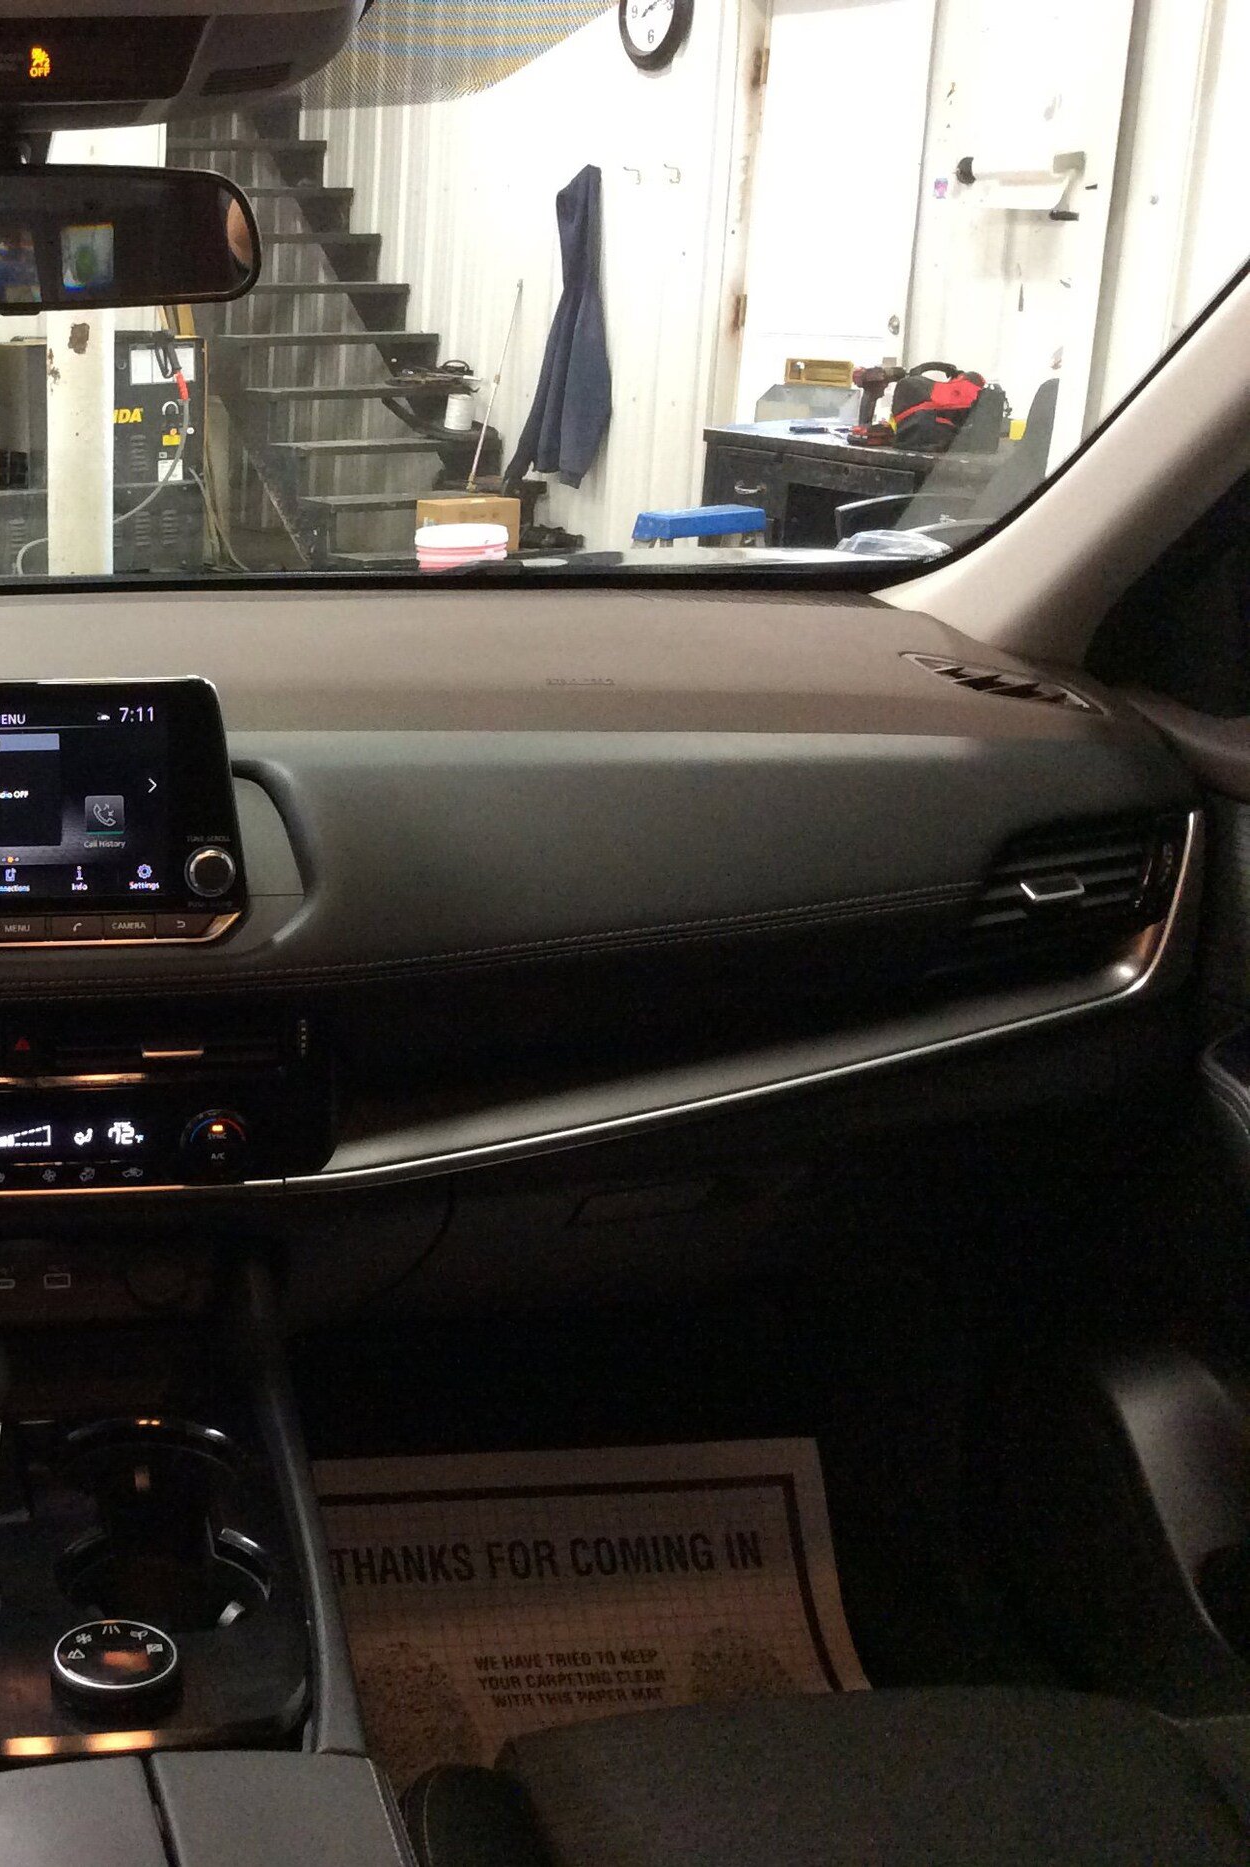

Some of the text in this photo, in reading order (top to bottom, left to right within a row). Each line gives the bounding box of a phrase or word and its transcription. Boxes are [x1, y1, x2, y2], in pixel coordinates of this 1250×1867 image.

[631, 5, 638, 18] 9
[648, 29, 654, 43] 6
[29, 67, 50, 78] OFF
[118, 707, 155, 723] 7:11
[13, 790, 29, 798] OFF
[83, 839, 126, 850] Call History
[71, 882, 88, 891] Info
[129, 881, 160, 891] Settings
[4, 924, 30, 933] MENU
[111, 921, 146, 930] CAMERA
[211, 1152, 225, 1161] A/C
[327, 1531, 763, 1586] THANKS FOR COMING IN
[474, 1648, 658, 1671] WE HAVE TRIED TO KEEP
[478, 1669, 666, 1690] YOUR CARPETING CLEAN
[491, 1686, 662, 1709] WITH THIS PAPER MAT
